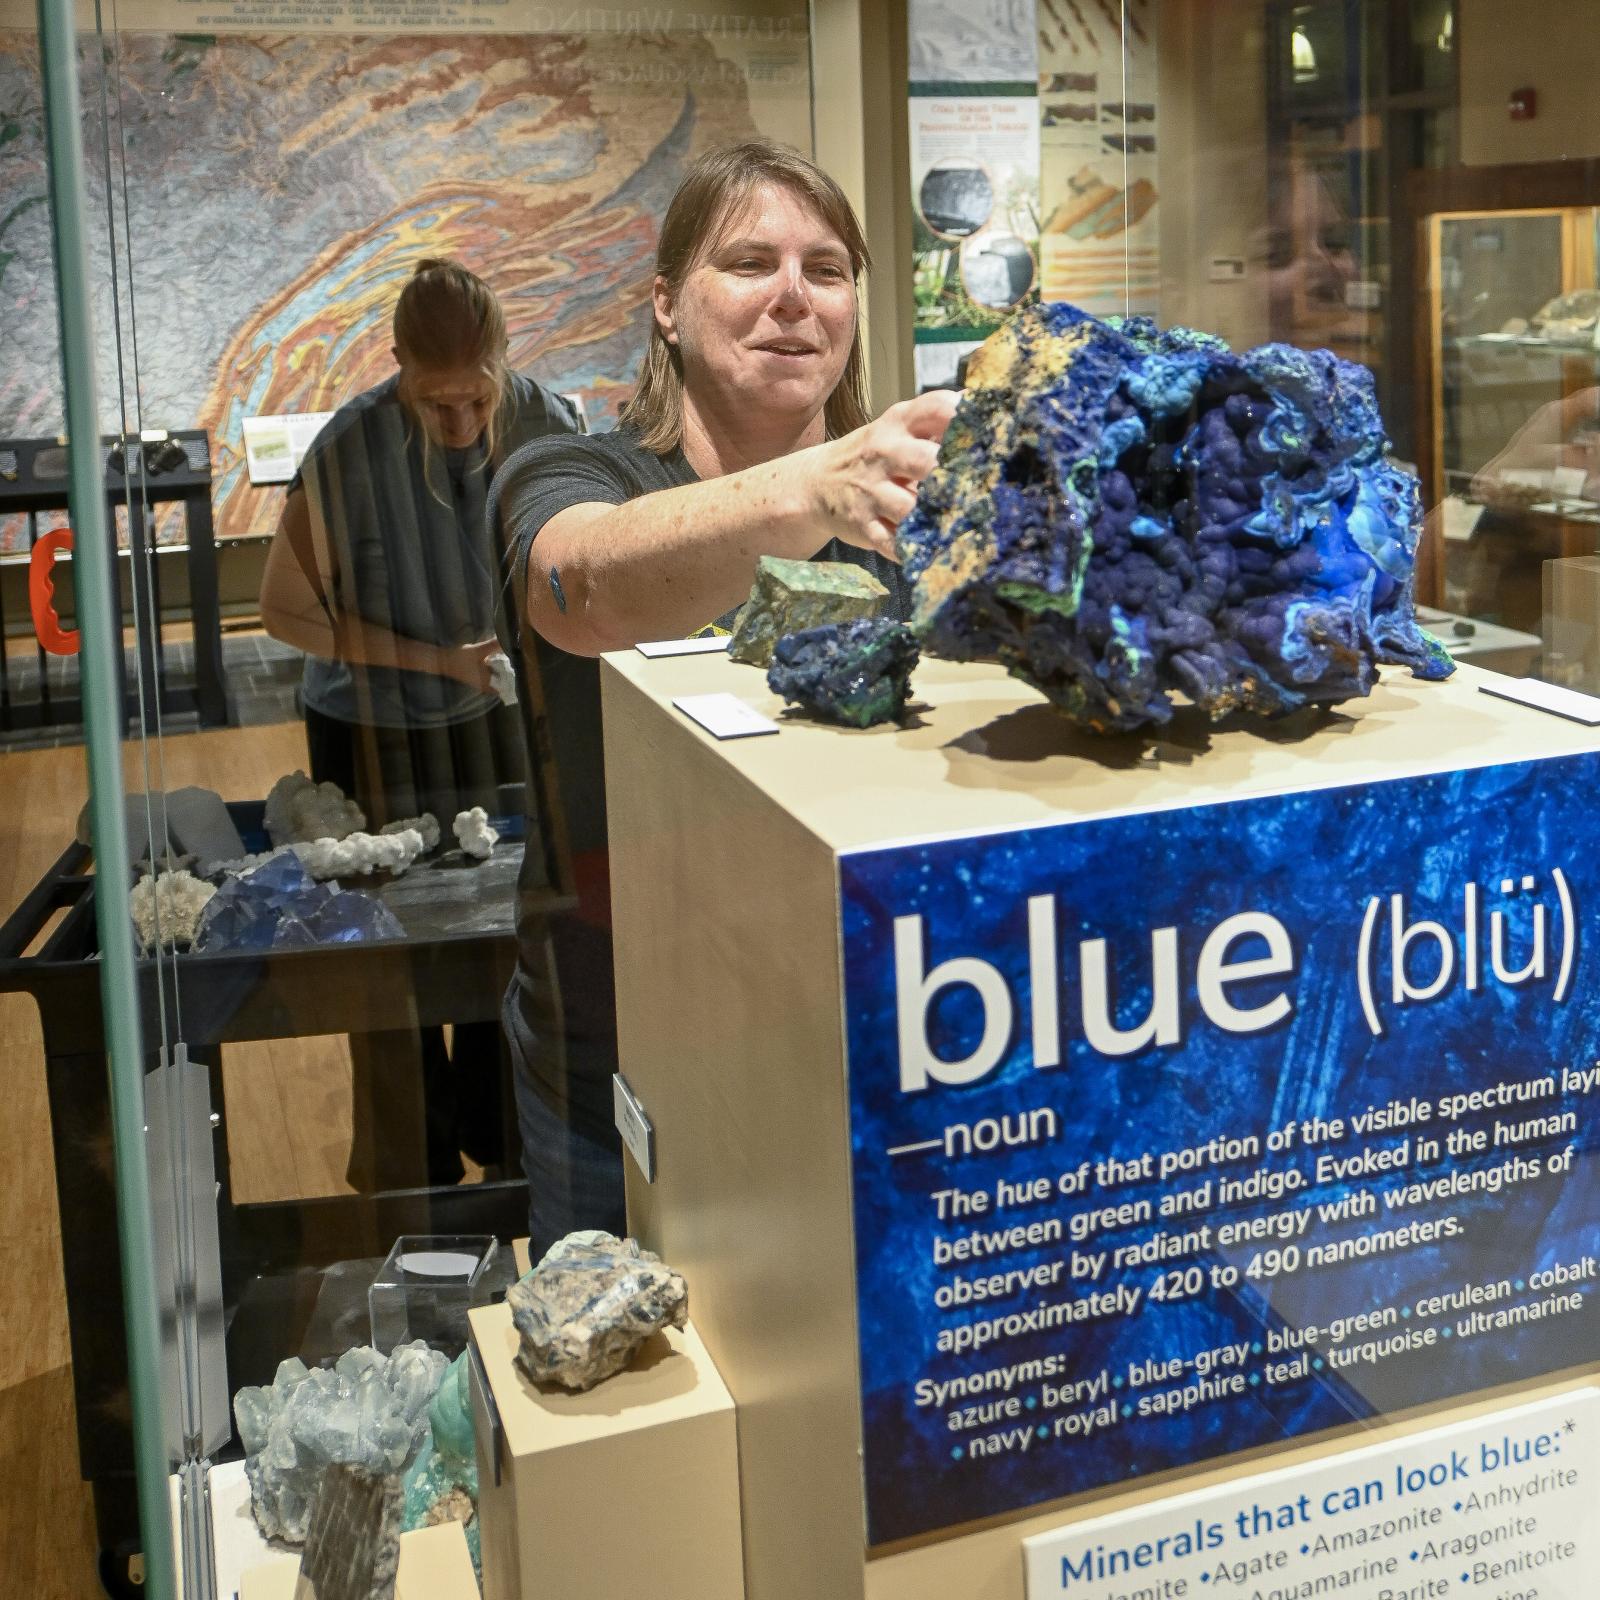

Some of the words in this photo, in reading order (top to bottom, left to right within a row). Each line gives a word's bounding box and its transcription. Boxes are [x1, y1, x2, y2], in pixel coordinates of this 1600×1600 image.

[894, 893, 1294, 1093] blue
[1357, 867, 1575, 1035] (blü)
[931, 1188, 988, 1219] The
[997, 1177, 1050, 1207] hue
[1058, 1162, 1090, 1194] of
[1096, 1153, 1153, 1186] that
[1160, 1135, 1259, 1180] portion
[1267, 1121, 1295, 1151] of
[1301, 1116, 1344, 1144] the
[1351, 1097, 1431, 1134] visible
[1438, 1075, 1554, 1121] spectrum
[1561, 1061, 1600, 1094] layi
[933, 1218, 1062, 1265] between
[1070, 1199, 1150, 1241] green
[1159, 1181, 1211, 1216] and
[1219, 1167, 1308, 1204] indigo.
[1315, 1141, 1408, 1183] Evoked
[1416, 1135, 1439, 1162] in
[1445, 1128, 1487, 1156] the
[1493, 1111, 1576, 1147] human
[934, 1259, 1064, 1309] observer
[1071, 1250, 1107, 1280] by
[1113, 1225, 1211, 1269] radiant
[1218, 1208, 1310, 1245] energy
[1318, 1188, 1376, 1223] with
[1384, 1155, 1541, 1209] wavelengths
[1547, 1145, 1575, 1173] of
[936, 1283, 1141, 1354] approximately
[1148, 1266, 1202, 1302] 420
[1209, 1262, 1239, 1288] to
[1246, 1244, 1300, 1279] 490
[1307, 1215, 1464, 1268] nanometers.
[914, 1353, 1066, 1406] Synonyms:
[947, 1396, 1021, 1431] azure
[1042, 1369, 1109, 1409] beryl
[1128, 1341, 1250, 1387] blue-gray
[1267, 1306, 1397, 1353] blue-green
[1415, 1277, 1511, 1318] cerulean
[1529, 1256, 1597, 1291] cobalt
[969, 1425, 1033, 1460] navy
[1054, 1399, 1118, 1437] royal
[1138, 1371, 1246, 1418] sapphire
[1264, 1353, 1309, 1385] teal
[1327, 1325, 1438, 1371] turquoise
[1456, 1290, 1583, 1338] ultramarine
[1060, 1519, 1225, 1590] Minerals
[1236, 1494, 1311, 1539] that
[1321, 1479, 1384, 1517] can
[1396, 1450, 1469, 1496] look
[1083, 1579, 1188, 1600] mite
[1212, 1550, 1289, 1586] Agate
[1310, 1505, 1443, 1559] Amazonite
[1463, 1466, 1579, 1515] Anhydrite
[1419, 1514, 1538, 1564] Aragonite
[1472, 1539, 1577, 1585] Benitoite
